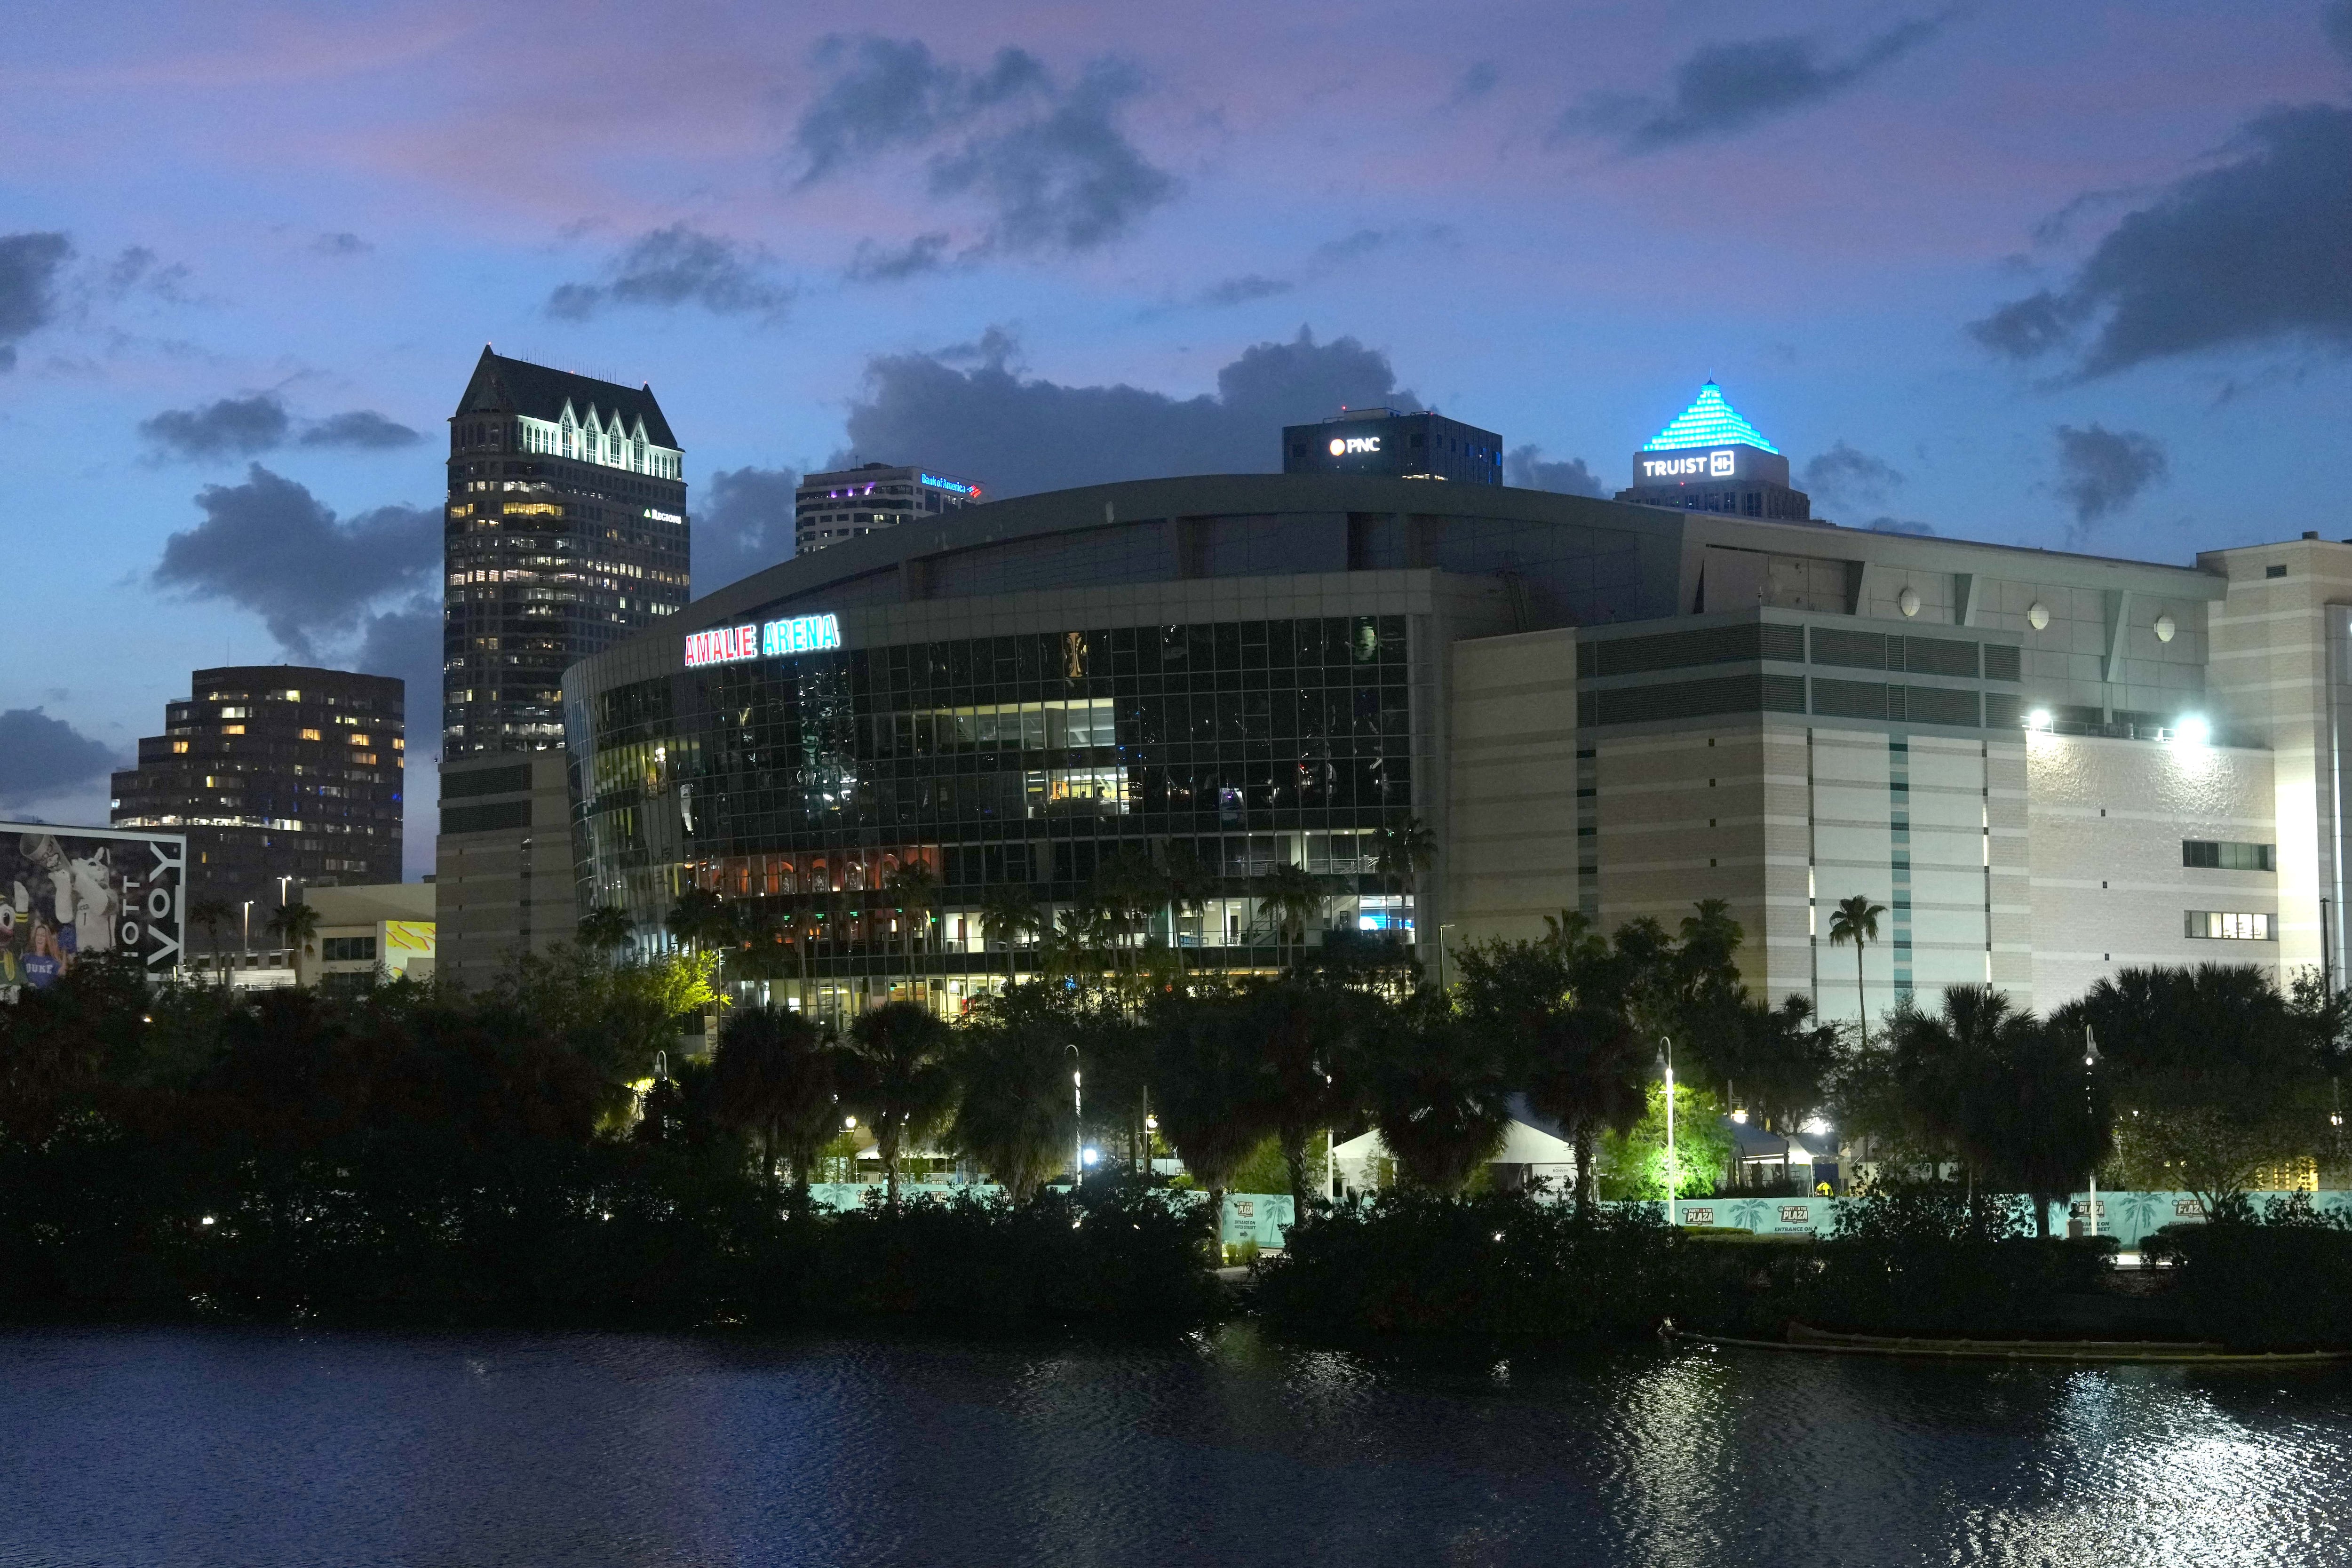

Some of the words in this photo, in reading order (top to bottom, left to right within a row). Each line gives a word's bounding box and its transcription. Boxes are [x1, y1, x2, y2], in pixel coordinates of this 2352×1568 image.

[1347, 437, 1380, 453] PNC
[1643, 457, 1708, 477] TRUIST
[922, 473, 937, 486] Bank
[937, 478, 943, 488] of
[943, 479, 966, 493] America
[685, 626, 756, 666] AMALIE
[763, 614, 840, 654] ARENA
[26, 963, 53, 974] DUKE
[1783, 1210, 1807, 1219] PLAZA
[2079, 1205, 2104, 1214] PLA
[1688, 1213, 1713, 1221] PLAZA
